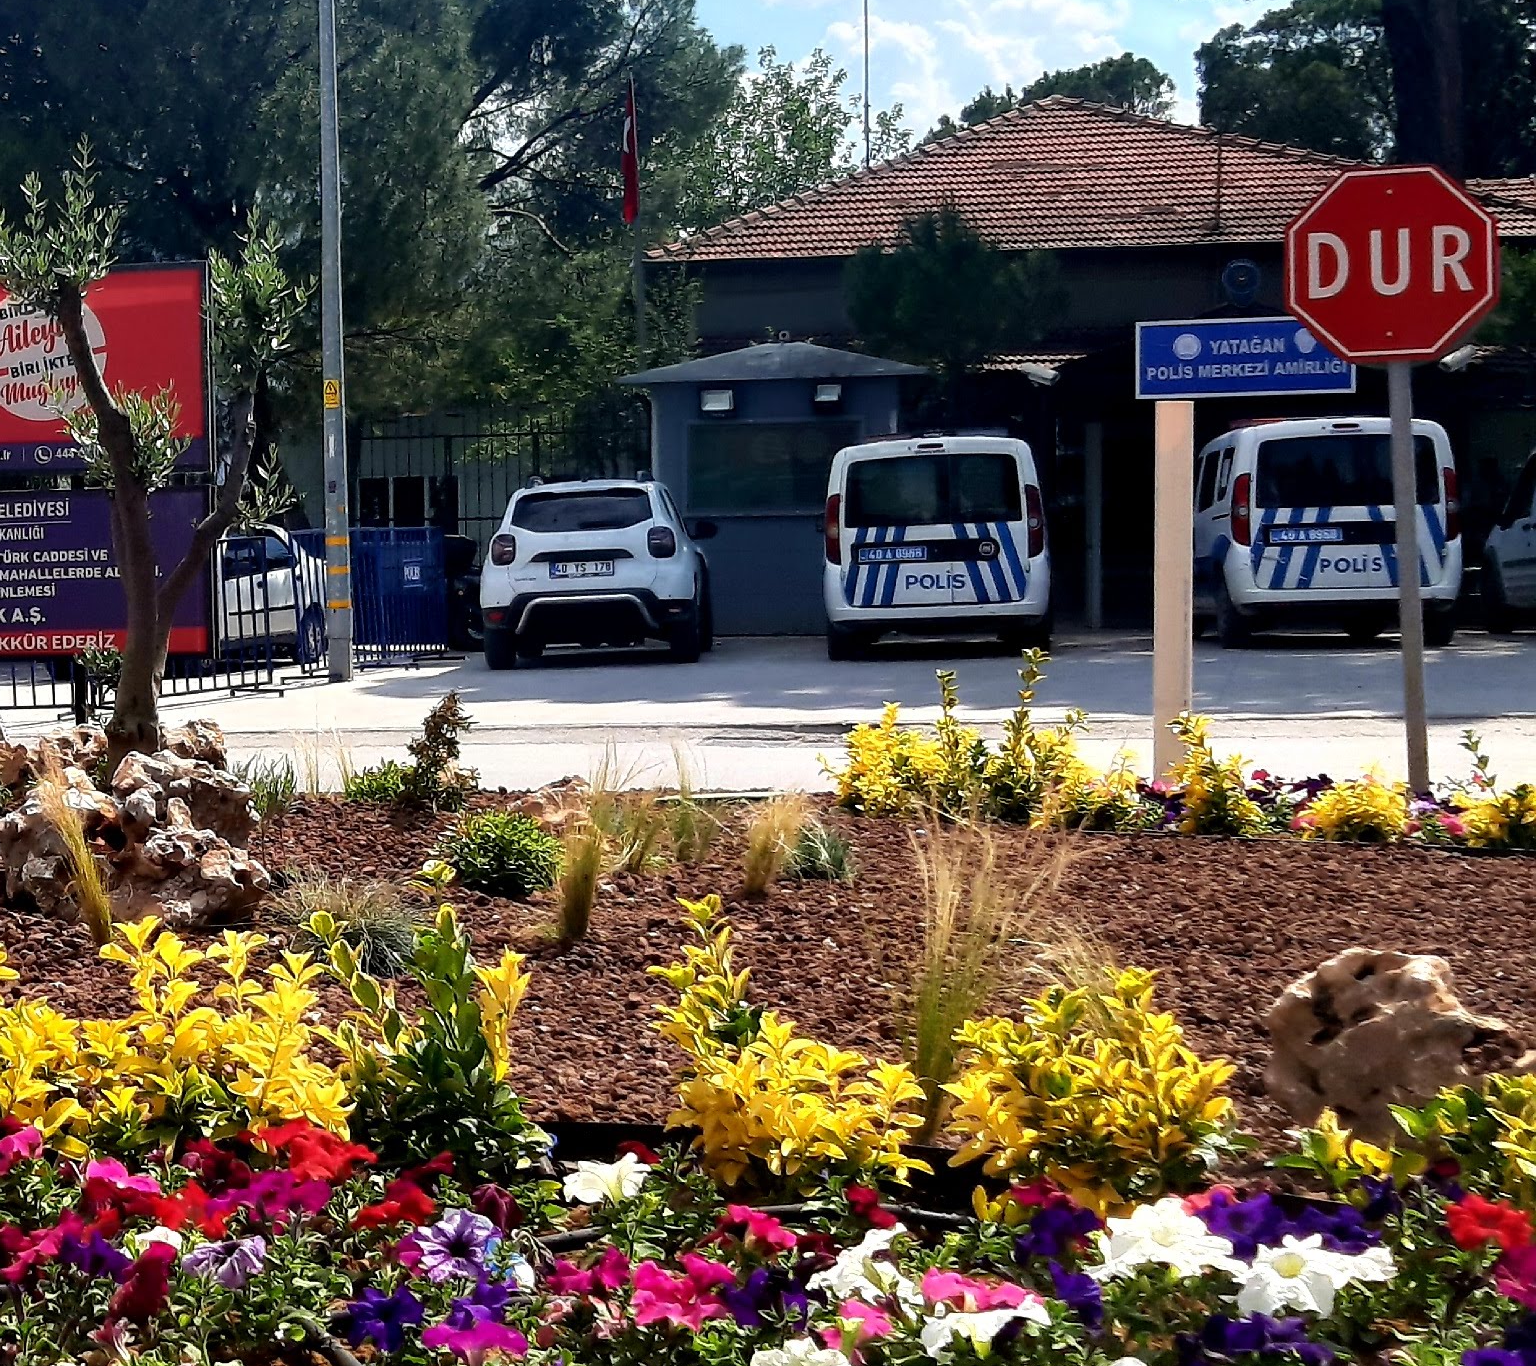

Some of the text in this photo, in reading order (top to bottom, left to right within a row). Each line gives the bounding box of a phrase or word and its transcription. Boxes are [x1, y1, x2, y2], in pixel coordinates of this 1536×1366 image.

[1307, 225, 1474, 299] DUR
[1209, 335, 1286, 355] YATAĞAN
[1146, 357, 1348, 381] POLİS MERKEZİ AMİRLİĞİ
[33, 547, 89, 563] CADDESİ
[91, 549, 108, 562] VE
[1319, 554, 1382, 573] POLİS
[0, 566, 101, 582] MAHALLELERDE
[574, 563, 586, 573] YS
[594, 561, 611, 572] 178
[905, 569, 967, 590] POLİS
[10, 606, 46, 626] A.Ş.
[52, 630, 116, 650] EDERİZ
